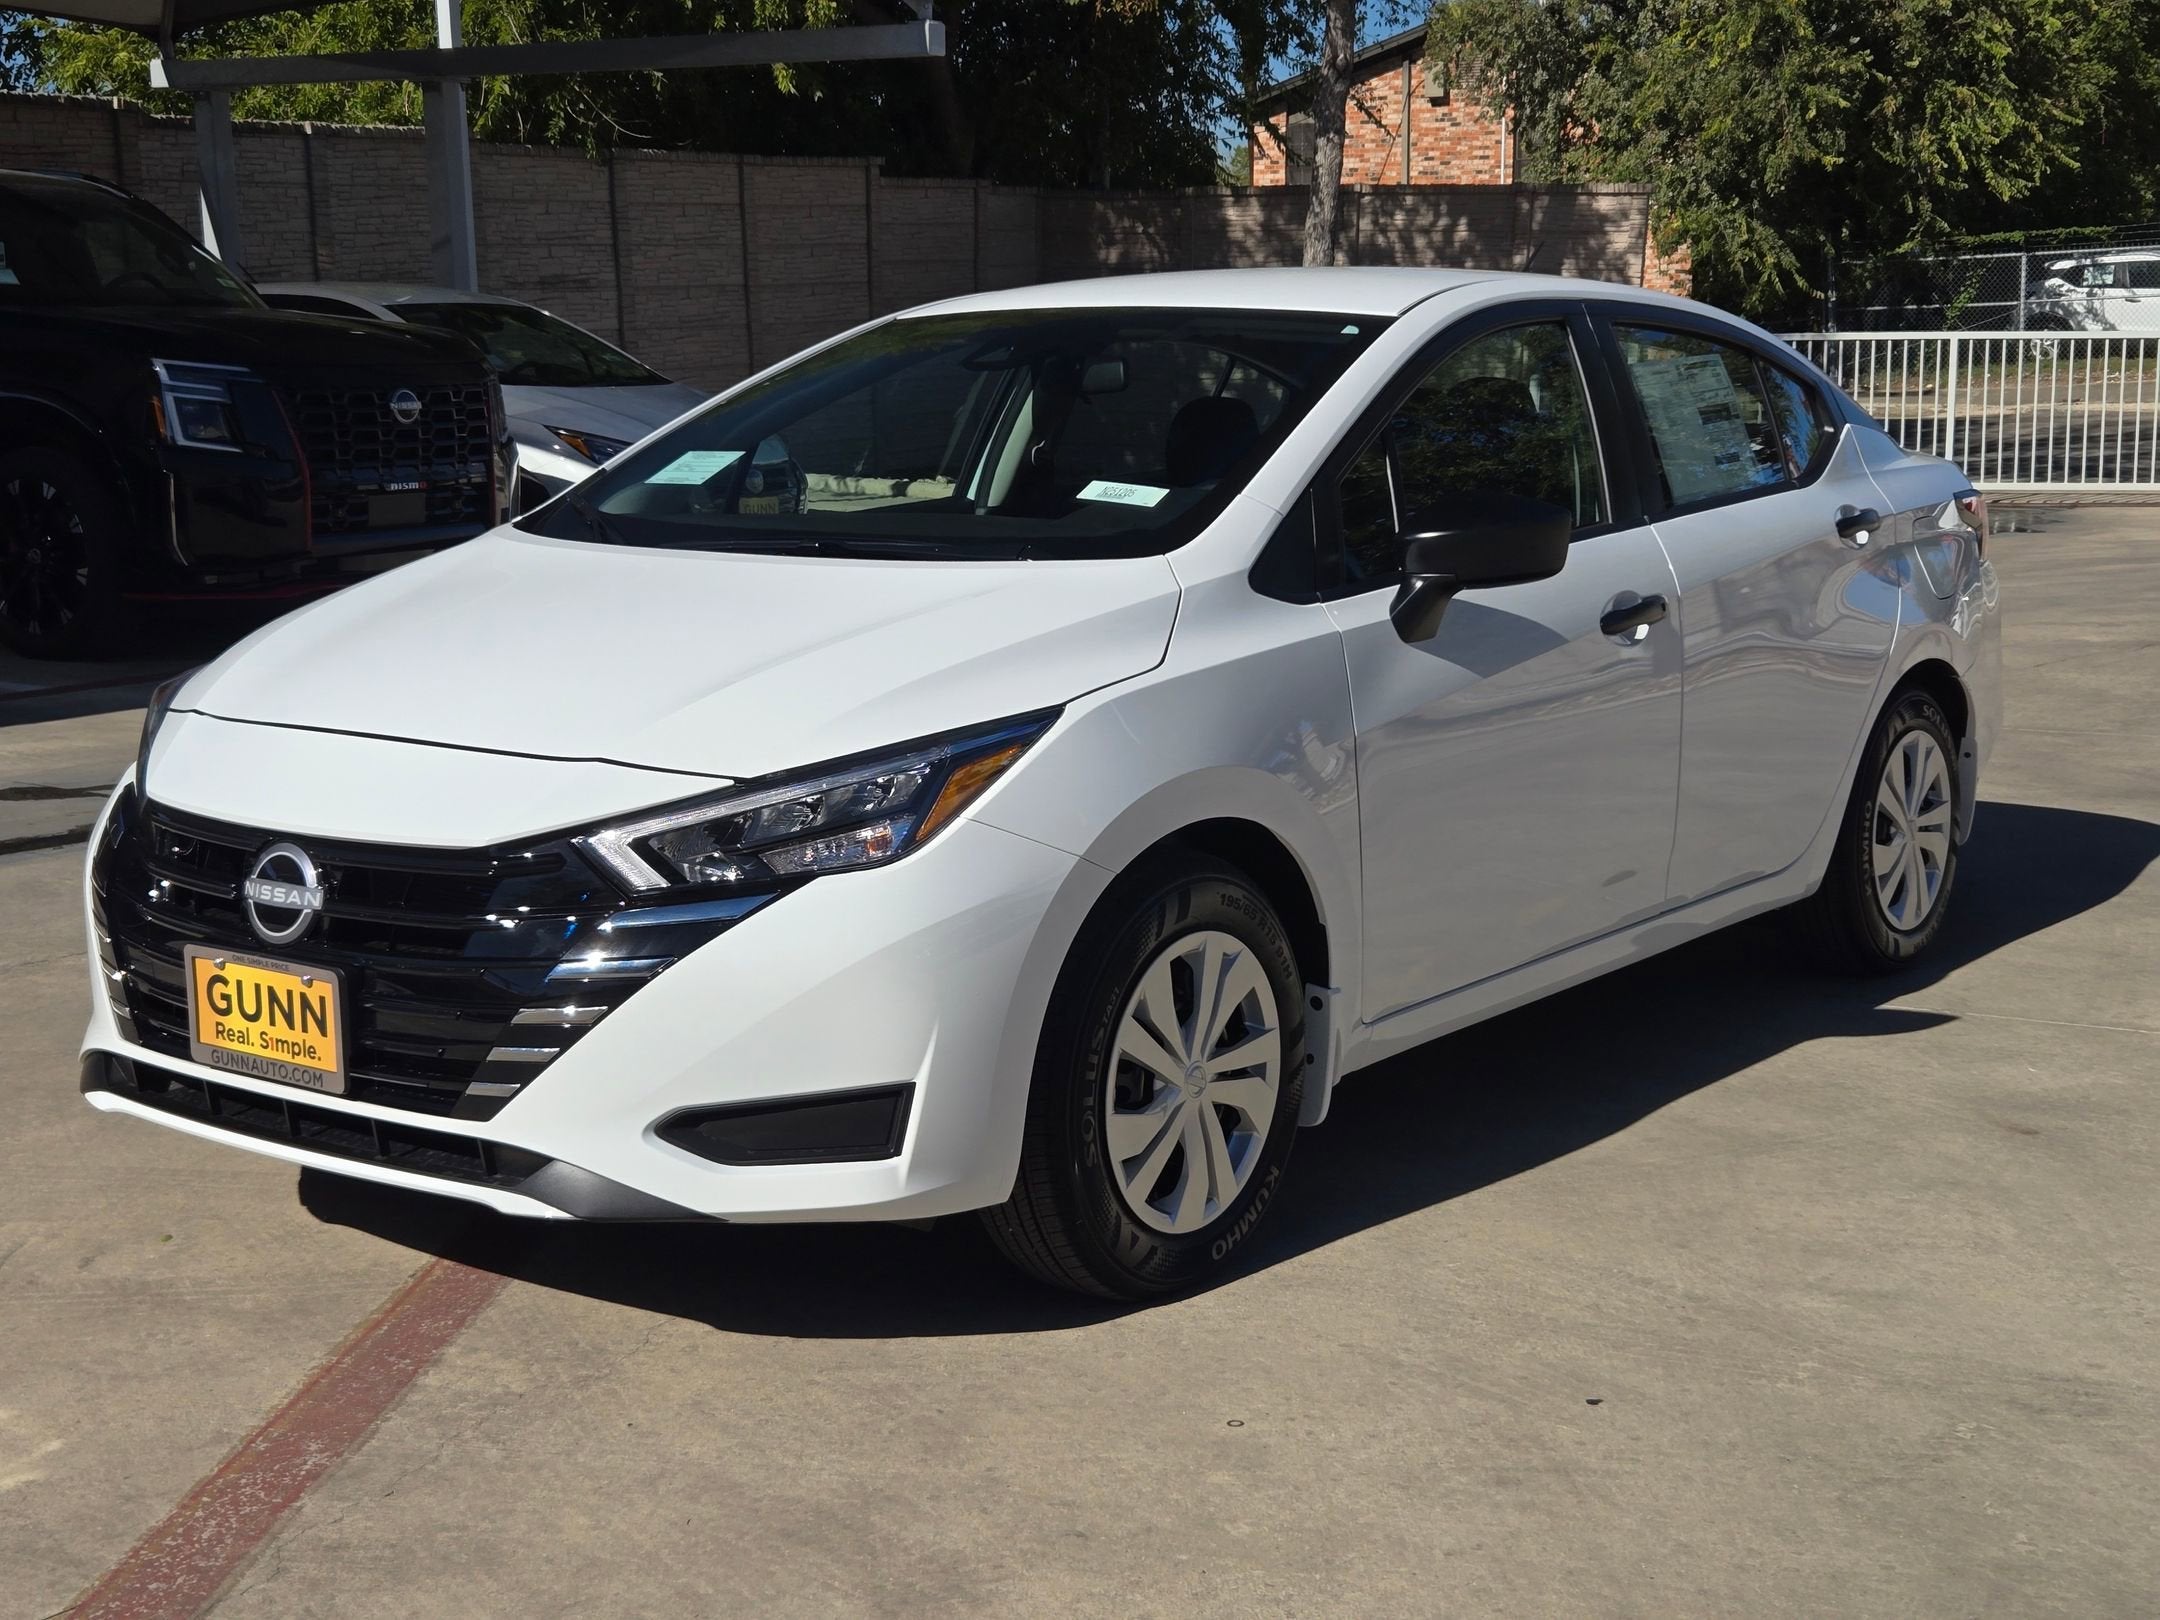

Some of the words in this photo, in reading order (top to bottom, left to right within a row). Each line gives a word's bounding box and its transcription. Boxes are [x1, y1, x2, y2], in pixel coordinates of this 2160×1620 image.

[391, 480, 430, 491] nismo
[245, 880, 322, 907] NISSAN
[1220, 893, 1258, 921] 195/65
[248, 957, 270, 968] SIMPLE
[271, 961, 289, 972] PRICE
[206, 974, 328, 1038] GUNN
[216, 1021, 255, 1048] Real.
[211, 1049, 324, 1089] GUNNAUTO.COM
[1081, 1025, 1105, 1167] SOLUS
[1212, 1165, 1280, 1260] KUMHO
